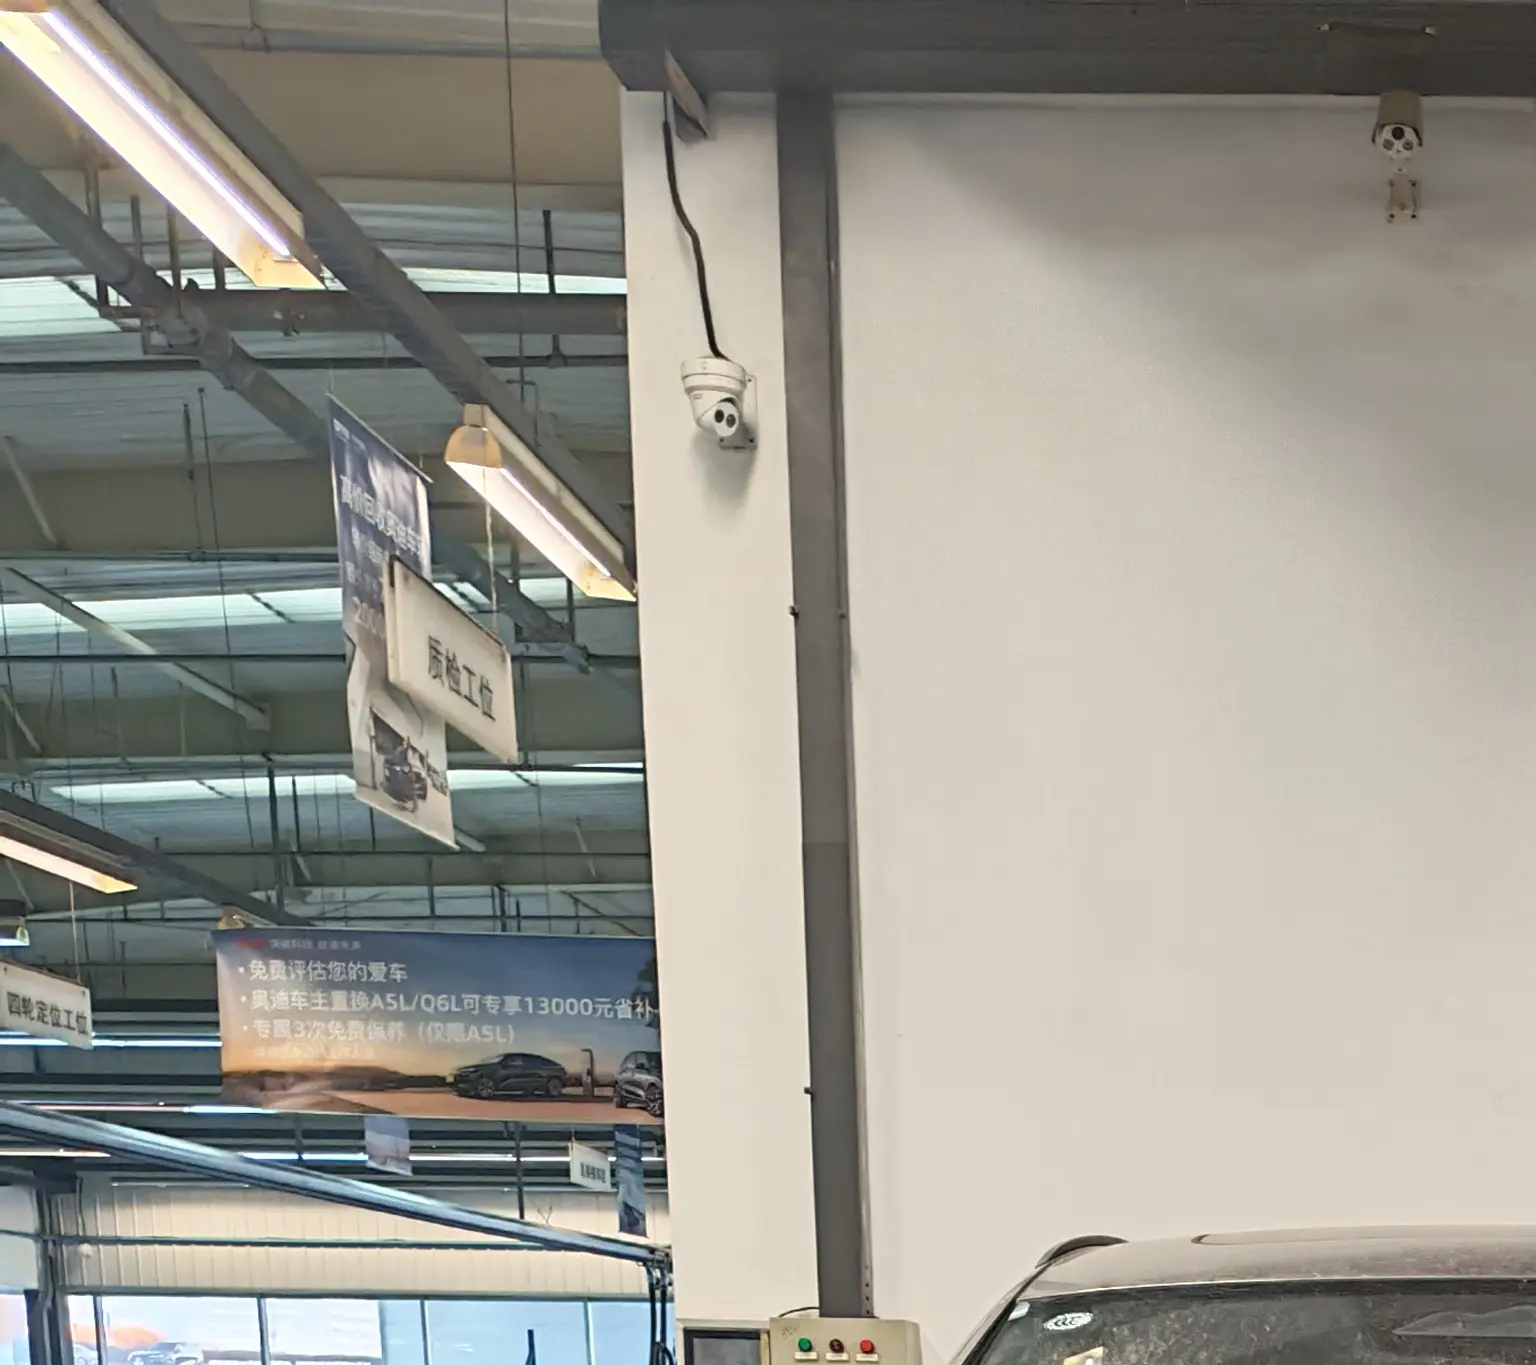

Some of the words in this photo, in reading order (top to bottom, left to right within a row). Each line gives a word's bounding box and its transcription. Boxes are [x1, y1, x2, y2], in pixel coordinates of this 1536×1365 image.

[428, 635, 496, 721] 质检工位
[248, 959, 408, 983] 免费评估您的爱车
[7, 991, 89, 1036] 四轮定位工位
